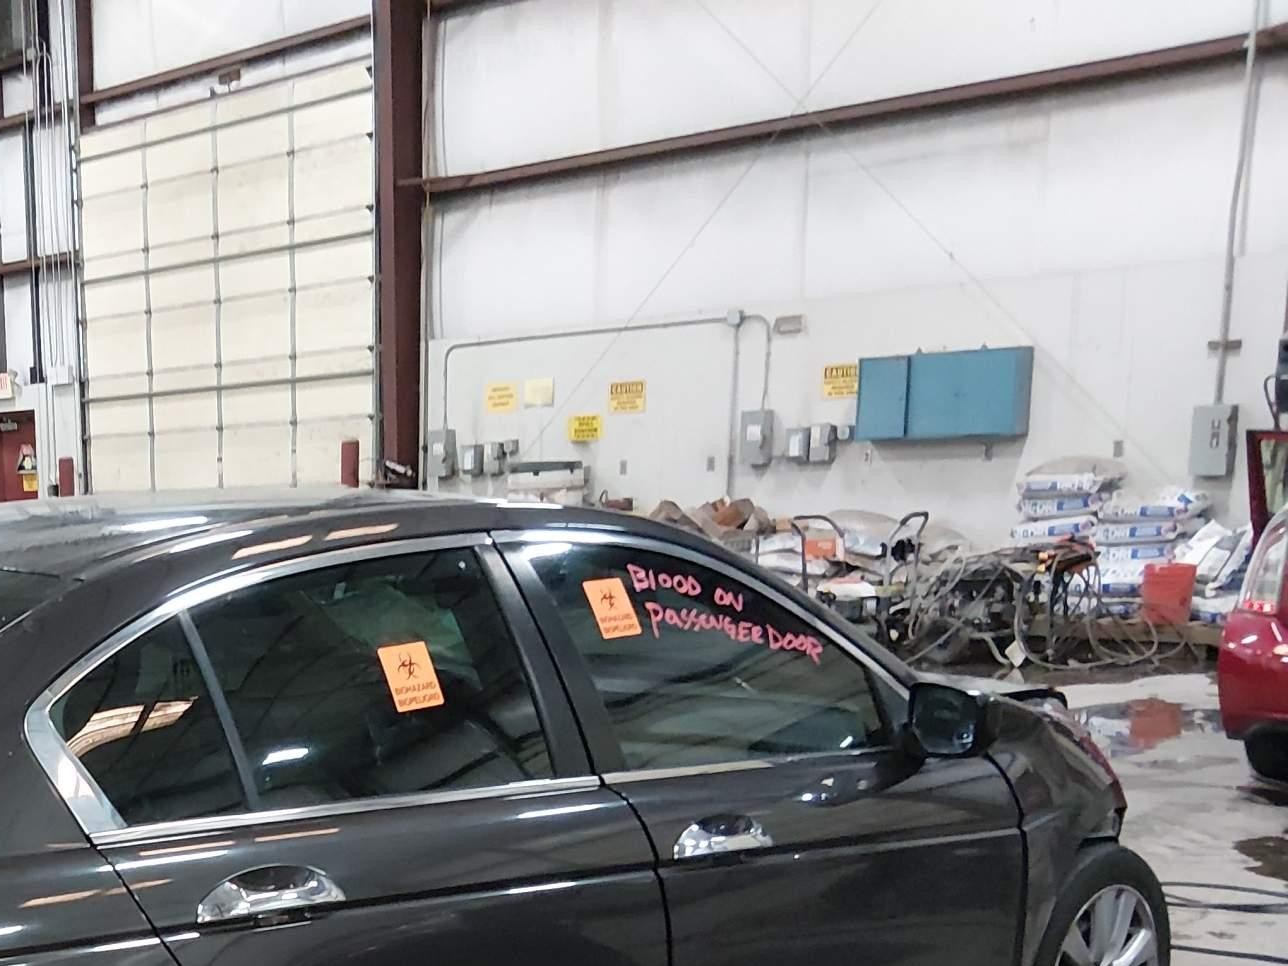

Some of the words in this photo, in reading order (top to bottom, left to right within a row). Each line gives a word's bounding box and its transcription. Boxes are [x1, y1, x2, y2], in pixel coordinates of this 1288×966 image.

[611, 381, 643, 393] CAUTION
[714, 587, 743, 612] ON
[766, 624, 823, 665] DOOR
[394, 681, 437, 696] BIOHAZARD
